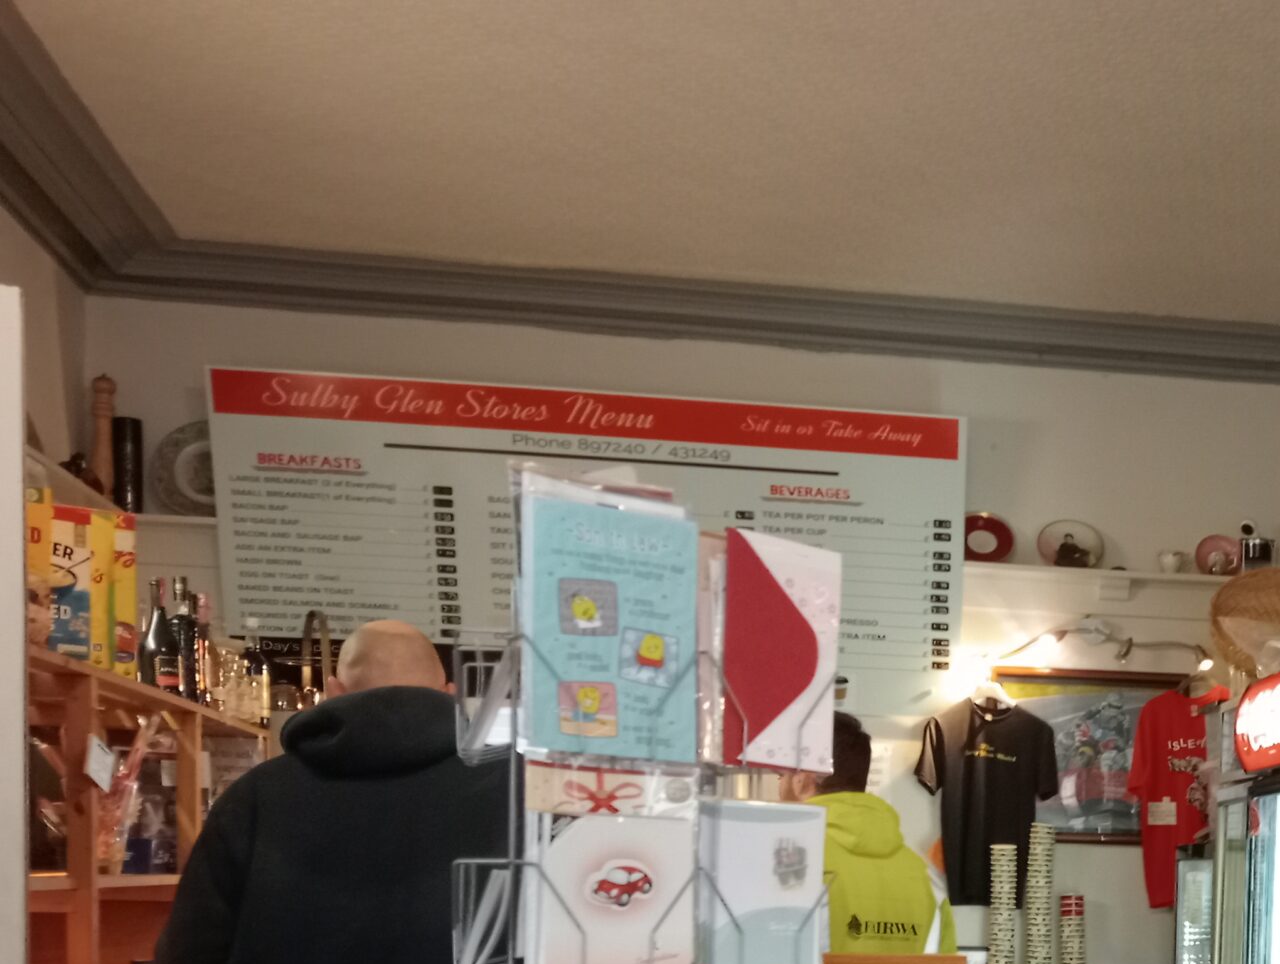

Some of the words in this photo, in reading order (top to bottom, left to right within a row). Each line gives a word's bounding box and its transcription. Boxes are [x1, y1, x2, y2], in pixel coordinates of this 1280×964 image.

[262, 376, 359, 418] Sulby
[374, 384, 444, 416] Glen
[456, 388, 549, 422] Stores
[564, 394, 655, 429] Menu
[740, 415, 770, 433] Sit
[774, 418, 792, 434] in
[796, 424, 814, 437] or
[821, 418, 864, 439] Take
[867, 422, 924, 447] Away
[512, 433, 571, 449] Phone
[577, 438, 646, 456] 897240
[668, 446, 732, 463] 431249
[257, 452, 362, 470] BREAKFASTS
[263, 476, 318, 485] BREAKFAST
[770, 484, 851, 500] BEVERAGES
[763, 511, 780, 519] TEA
[784, 511, 803, 520] PER
[806, 512, 825, 521] POT
[829, 514, 848, 522] PER
[763, 525, 780, 533] TEA
[784, 526, 803, 534] PER
[806, 527, 827, 535] CUP
[840, 618, 880, 627] PRESSO
[863, 633, 887, 641] ITEM
[262, 640, 300, 654] Day's
[1168, 738, 1196, 751] ISLE
